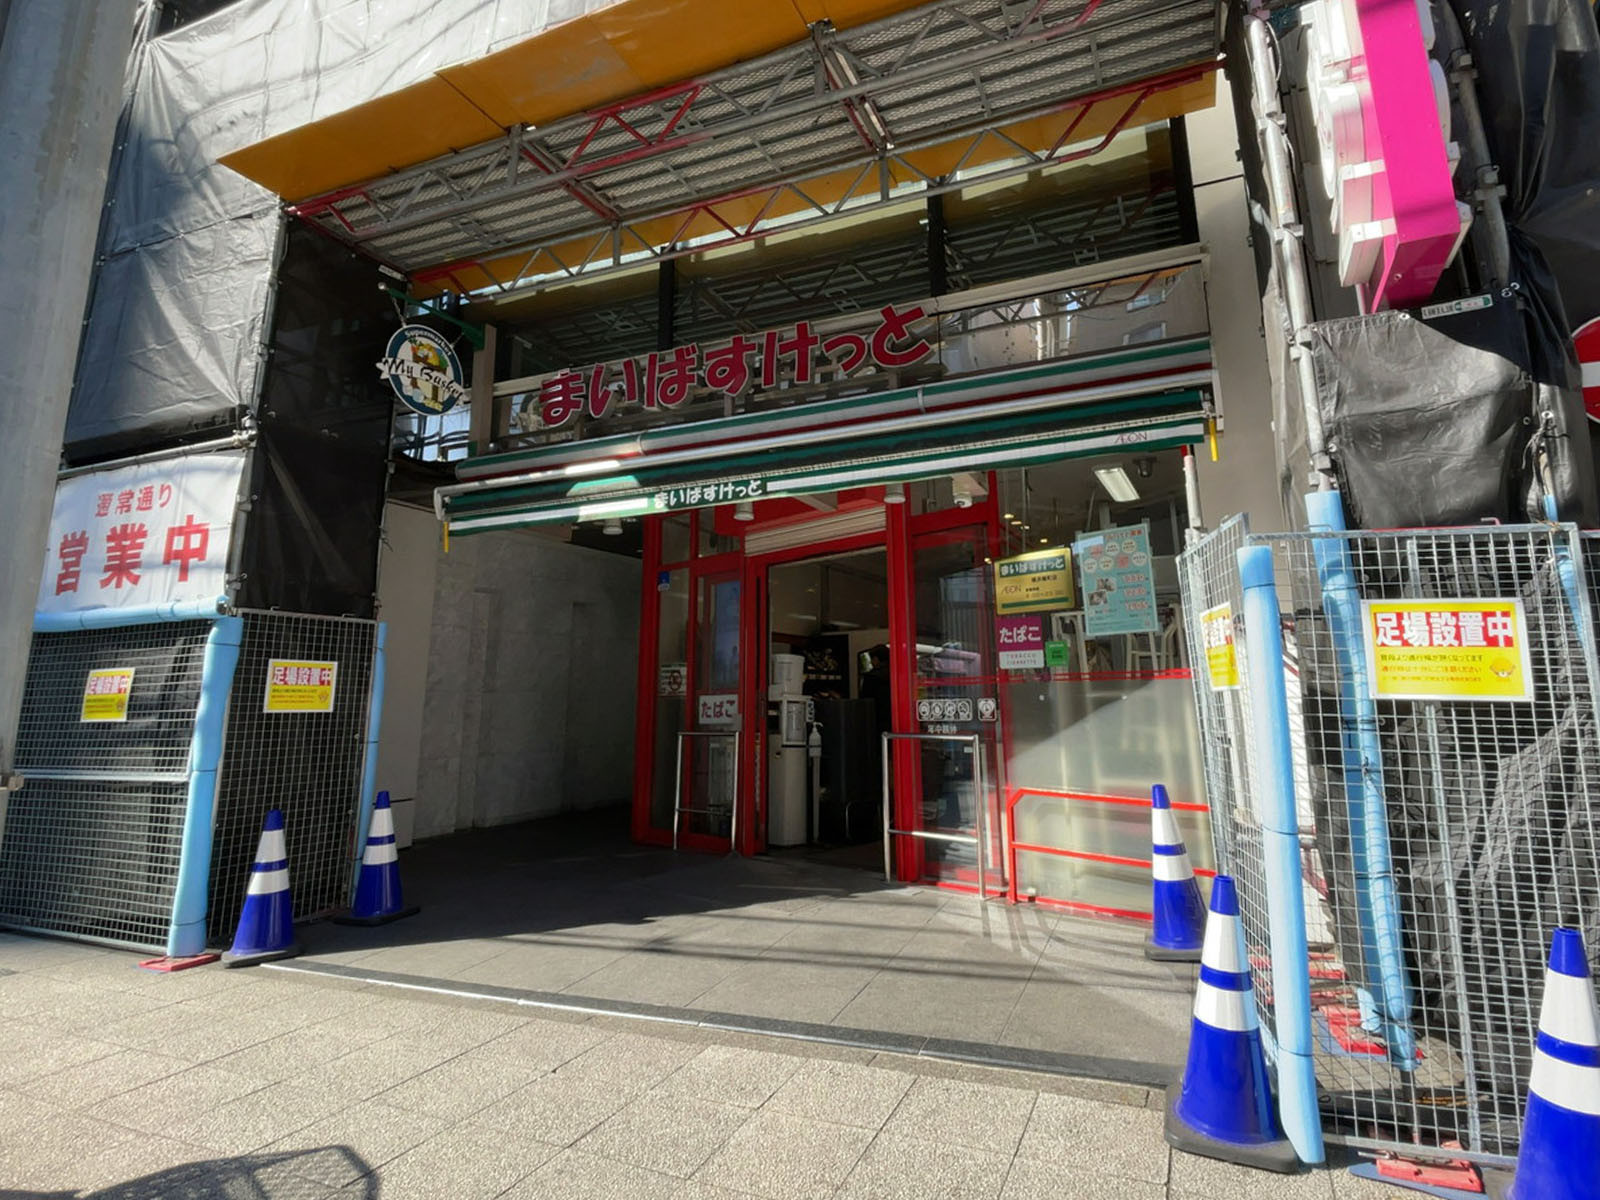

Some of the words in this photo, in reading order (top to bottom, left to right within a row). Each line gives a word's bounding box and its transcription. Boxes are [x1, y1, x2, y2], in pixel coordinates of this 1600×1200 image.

[382, 358, 414, 379] My
[539, 304, 931, 426] まいばすけっと
[95, 483, 173, 518] 通常通り
[654, 479, 763, 509] まいばすけっと
[55, 514, 211, 596] 営業中
[999, 625, 1041, 643] たばこ
[1375, 611, 1513, 647] 足場設置中
[701, 700, 735, 718] たばこ
